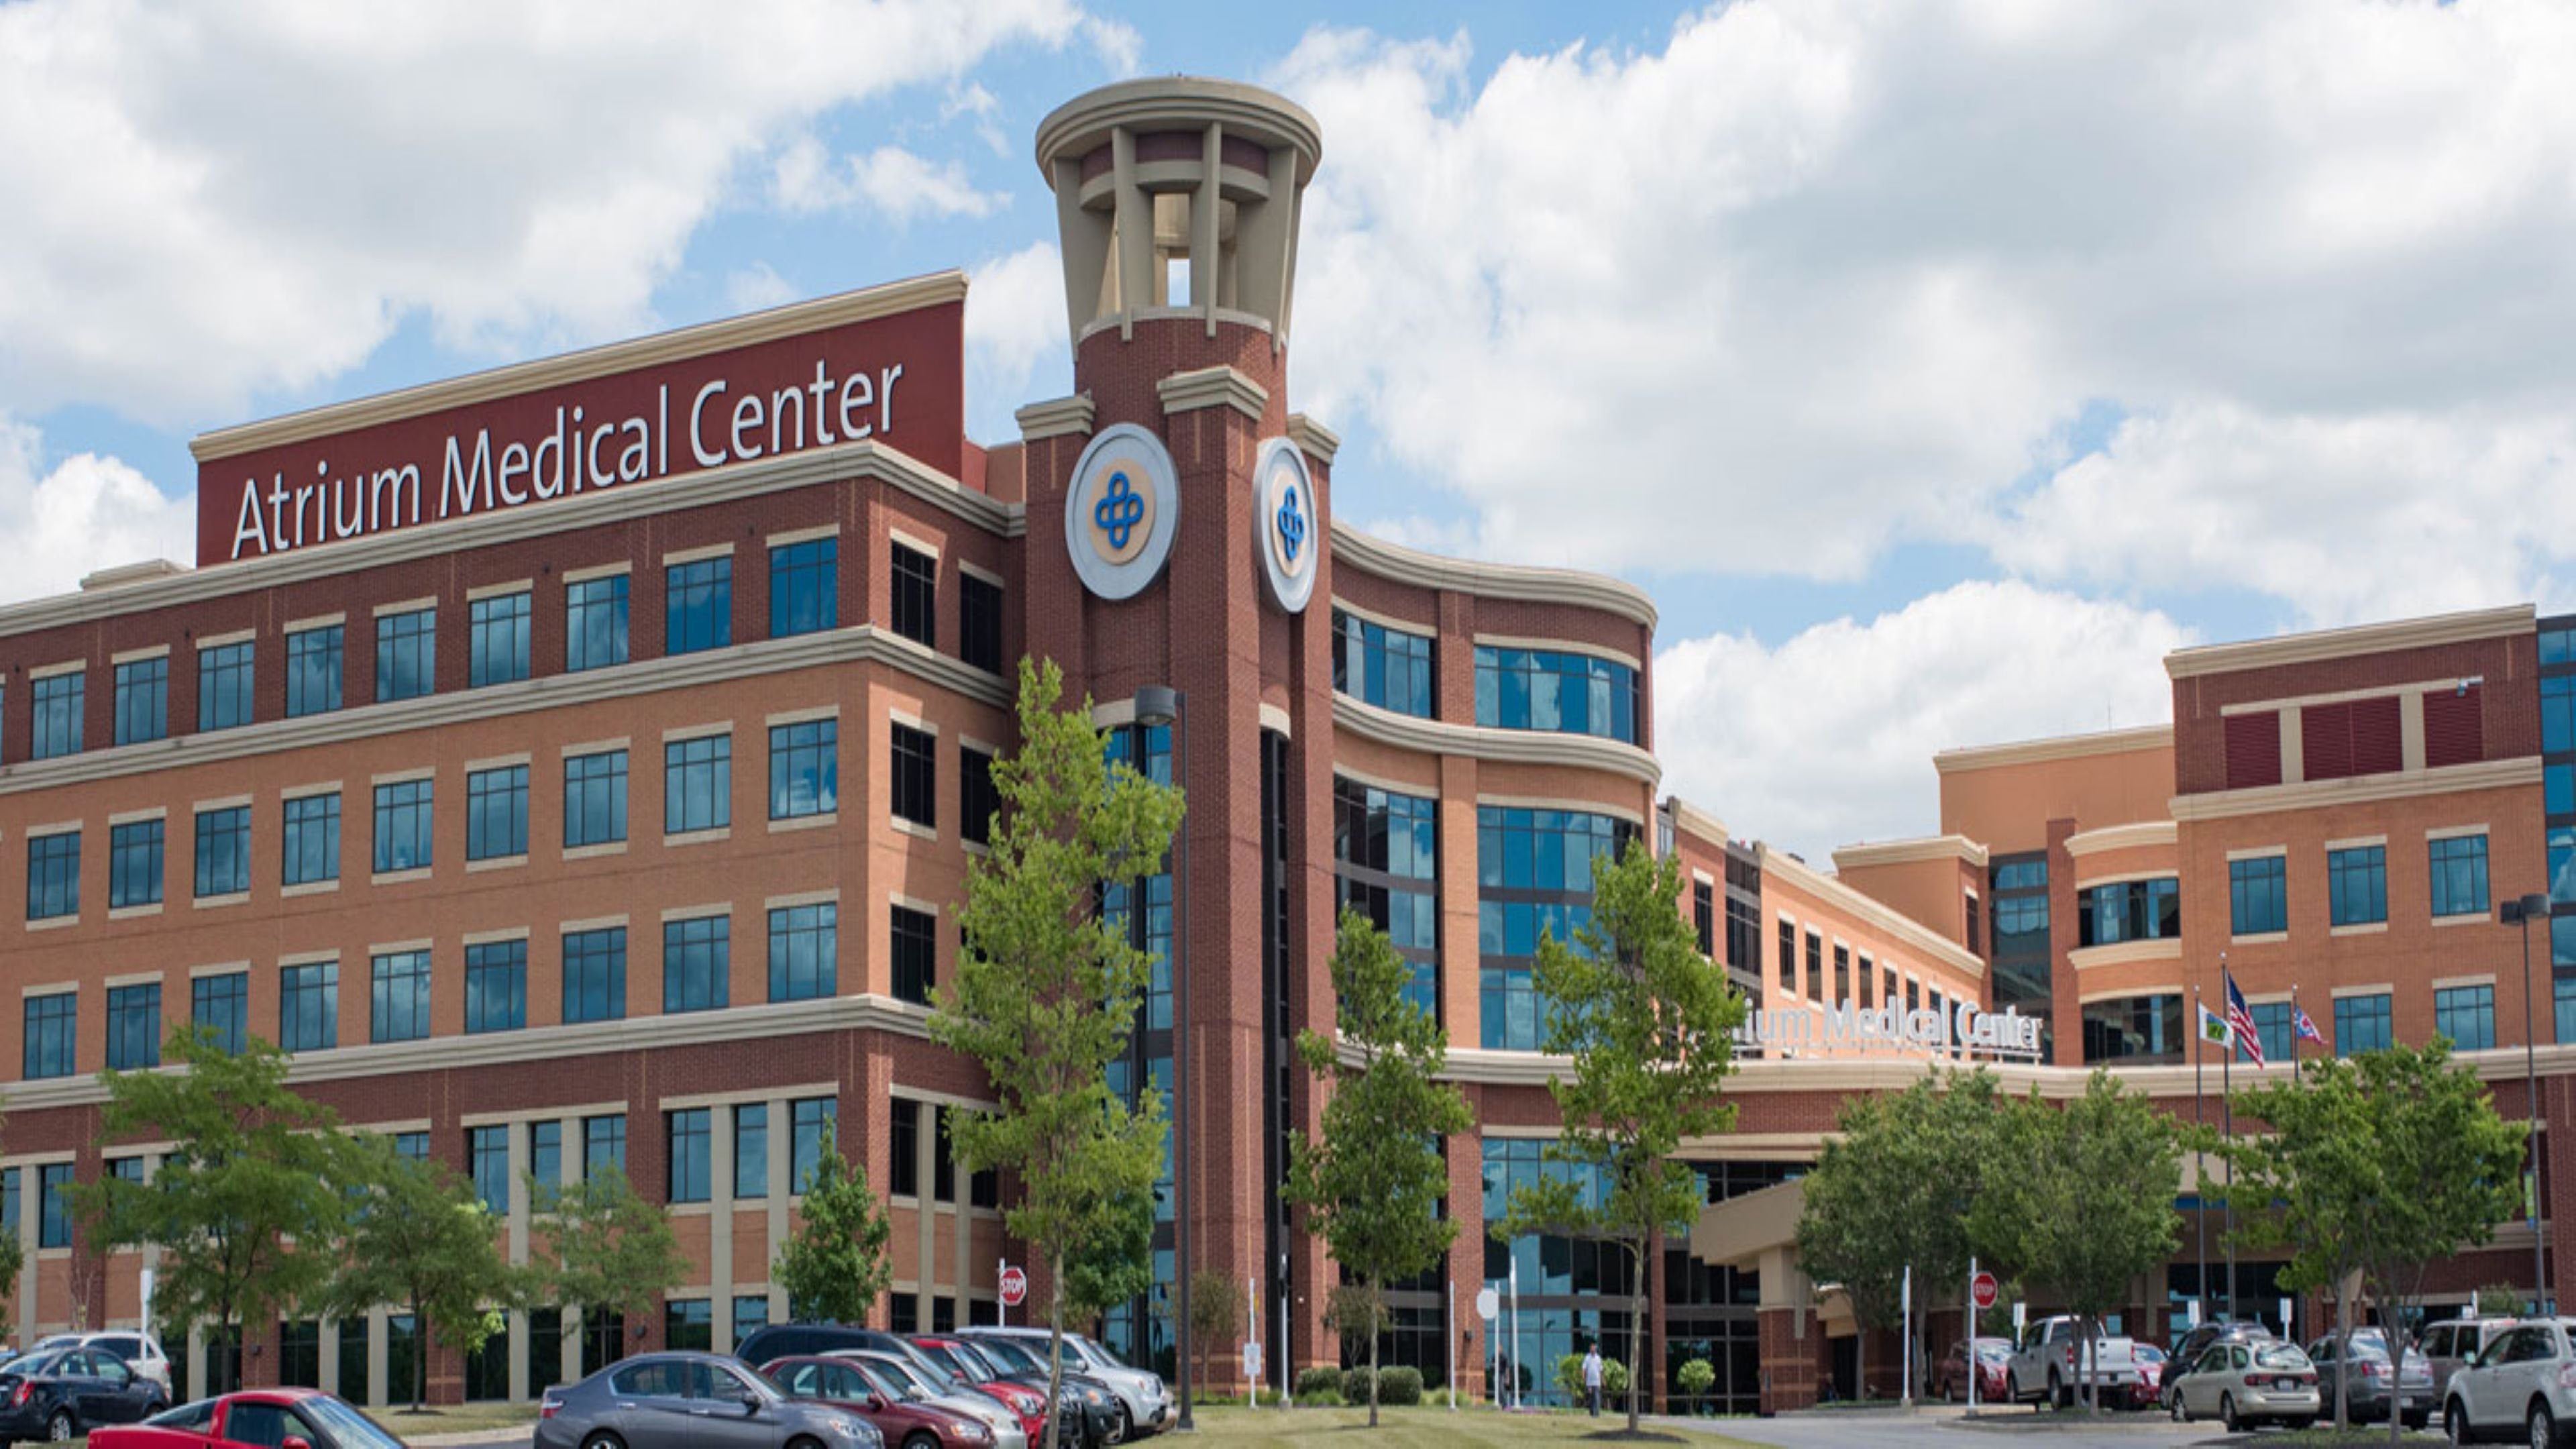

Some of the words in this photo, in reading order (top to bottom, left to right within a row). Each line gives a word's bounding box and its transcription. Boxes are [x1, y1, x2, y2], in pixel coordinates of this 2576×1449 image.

[231, 460, 421, 560] Atrium
[439, 383, 668, 518] Medical
[690, 359, 902, 468] Center
[1823, 996, 1949, 1044] Medical
[1956, 1000, 2043, 1050] Center
[1001, 1277, 1024, 1295] STOP
[1975, 1283, 1994, 1296] STOP
